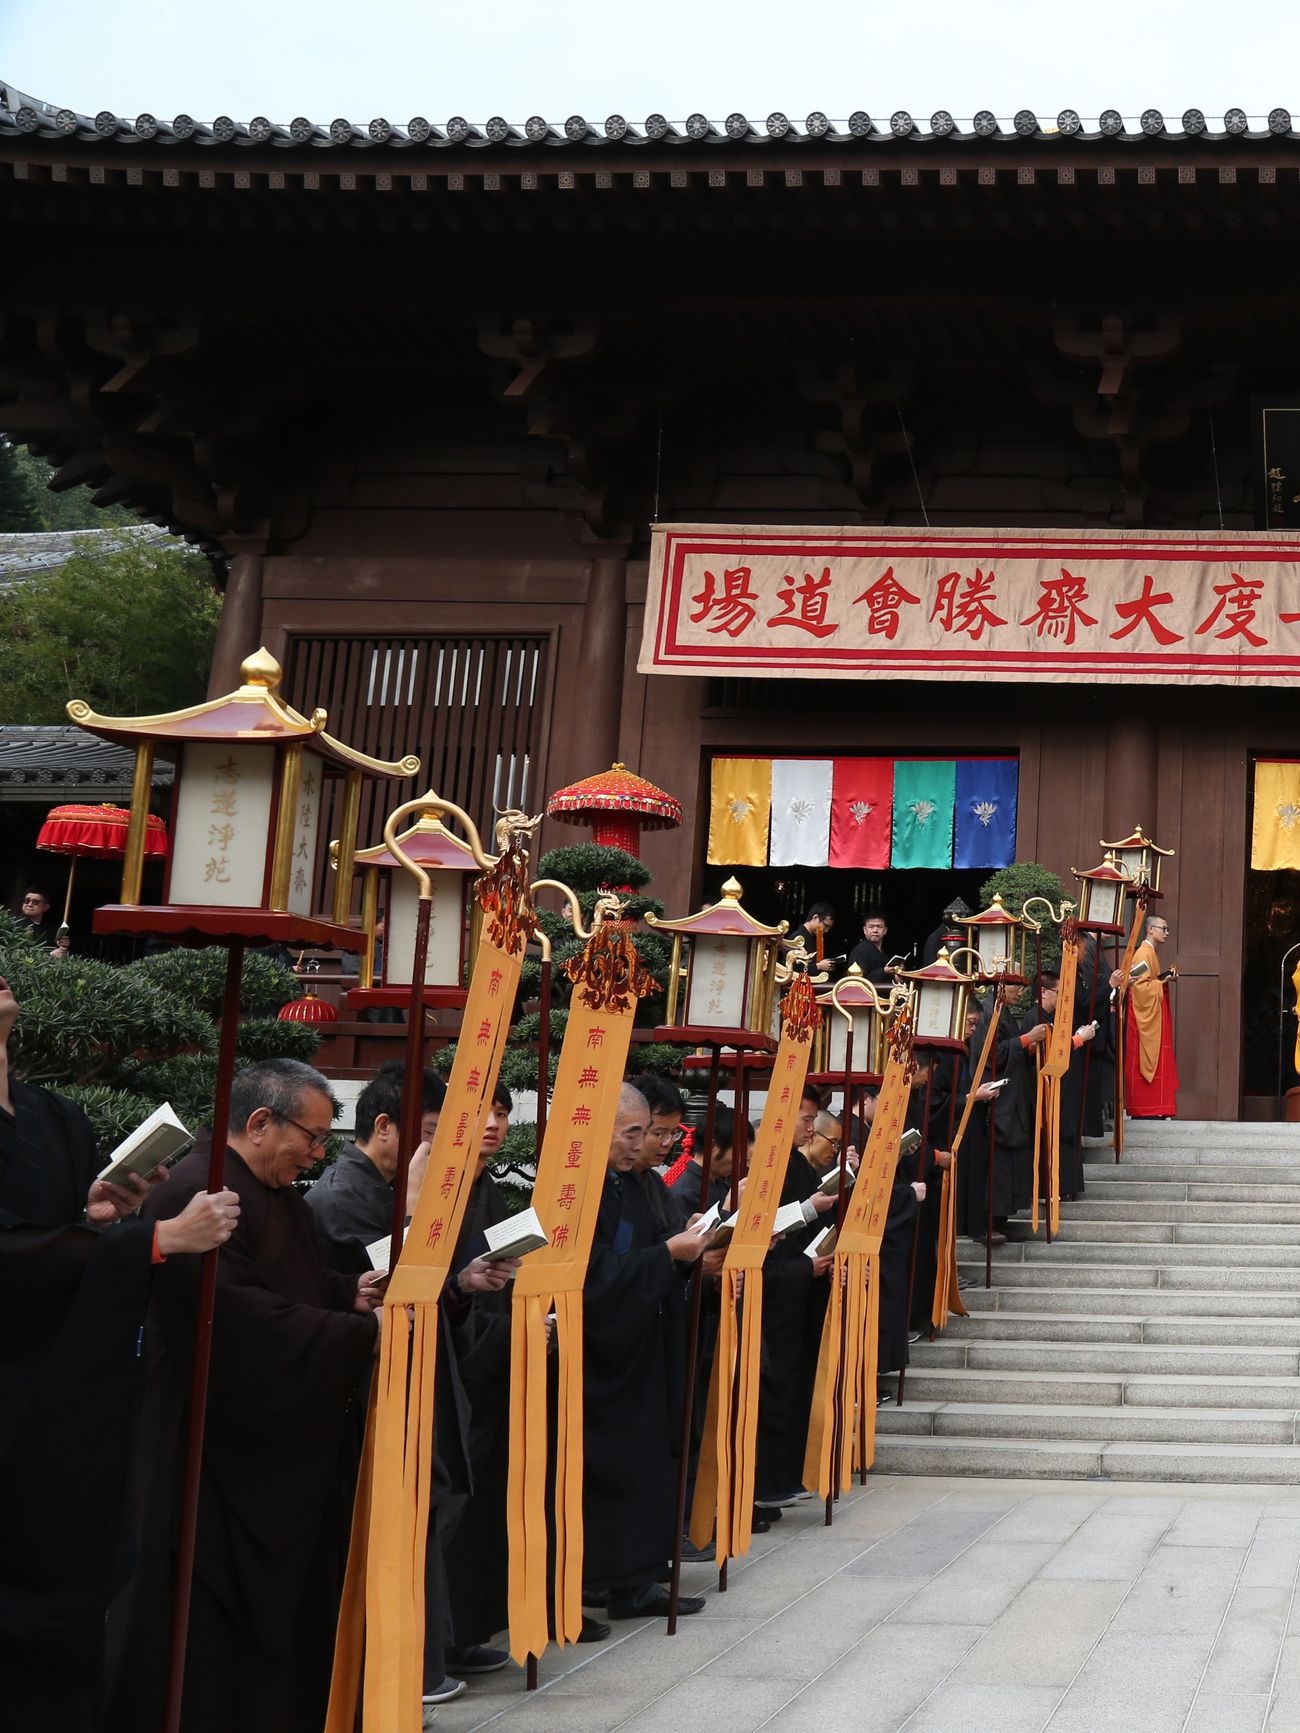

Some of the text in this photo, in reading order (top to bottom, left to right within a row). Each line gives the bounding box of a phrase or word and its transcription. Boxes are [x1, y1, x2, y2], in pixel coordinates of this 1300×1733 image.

[204, 755, 241, 884] 志蓮淨苑
[551, 1026, 606, 1249] 南無無量壽佛
